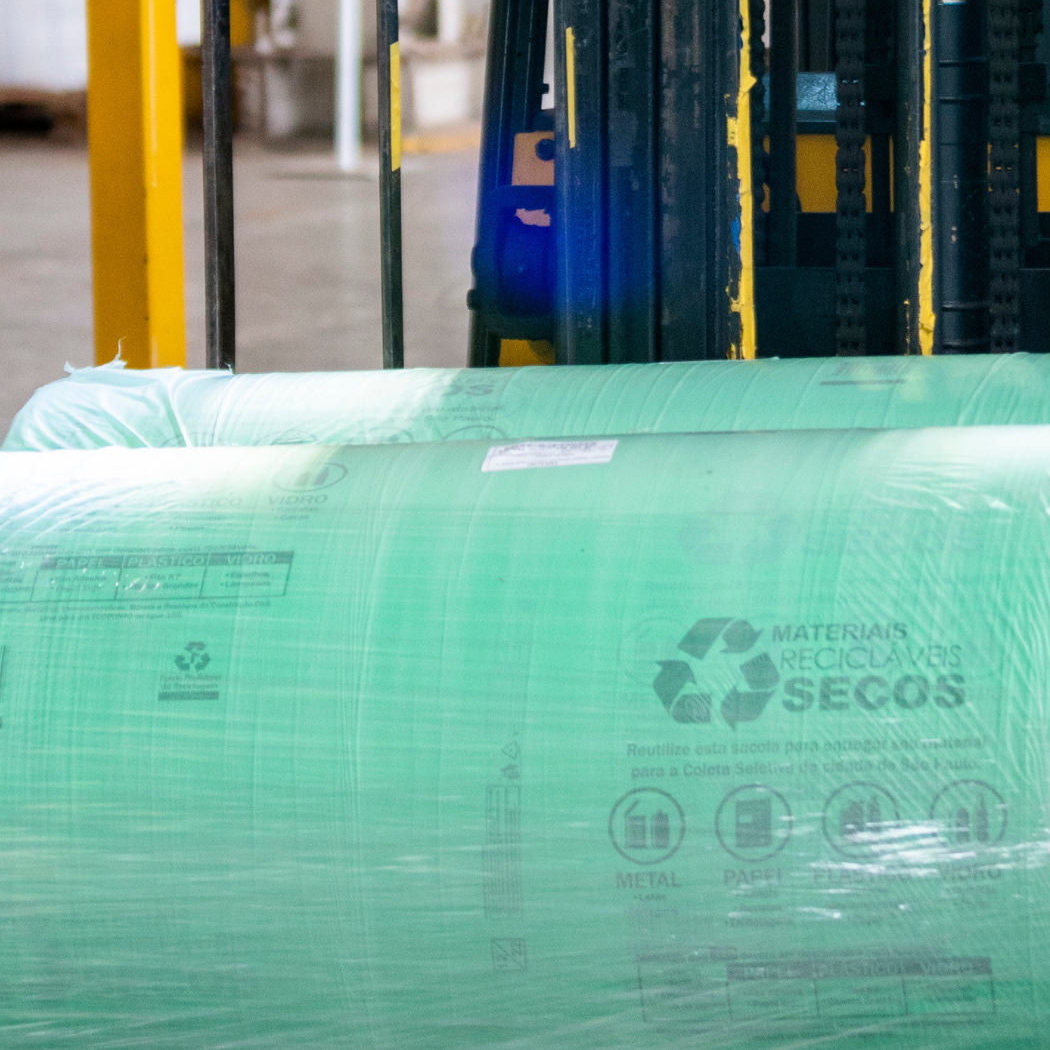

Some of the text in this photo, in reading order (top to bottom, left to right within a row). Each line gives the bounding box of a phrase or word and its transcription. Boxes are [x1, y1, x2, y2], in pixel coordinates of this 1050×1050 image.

[268, 494, 329, 505] VIDRO
[57, 558, 104, 569] PAPEL
[226, 554, 276, 565] VIDRO
[772, 622, 908, 642] MATERIAIS
[782, 673, 966, 713] SECOS
[626, 743, 691, 757] Reutilize
[695, 741, 727, 755] esta
[731, 740, 780, 755] sacola
[631, 766, 665, 781] para
[669, 766, 679, 778] a
[683, 763, 731, 778] Coleta
[616, 871, 682, 889] METAL
